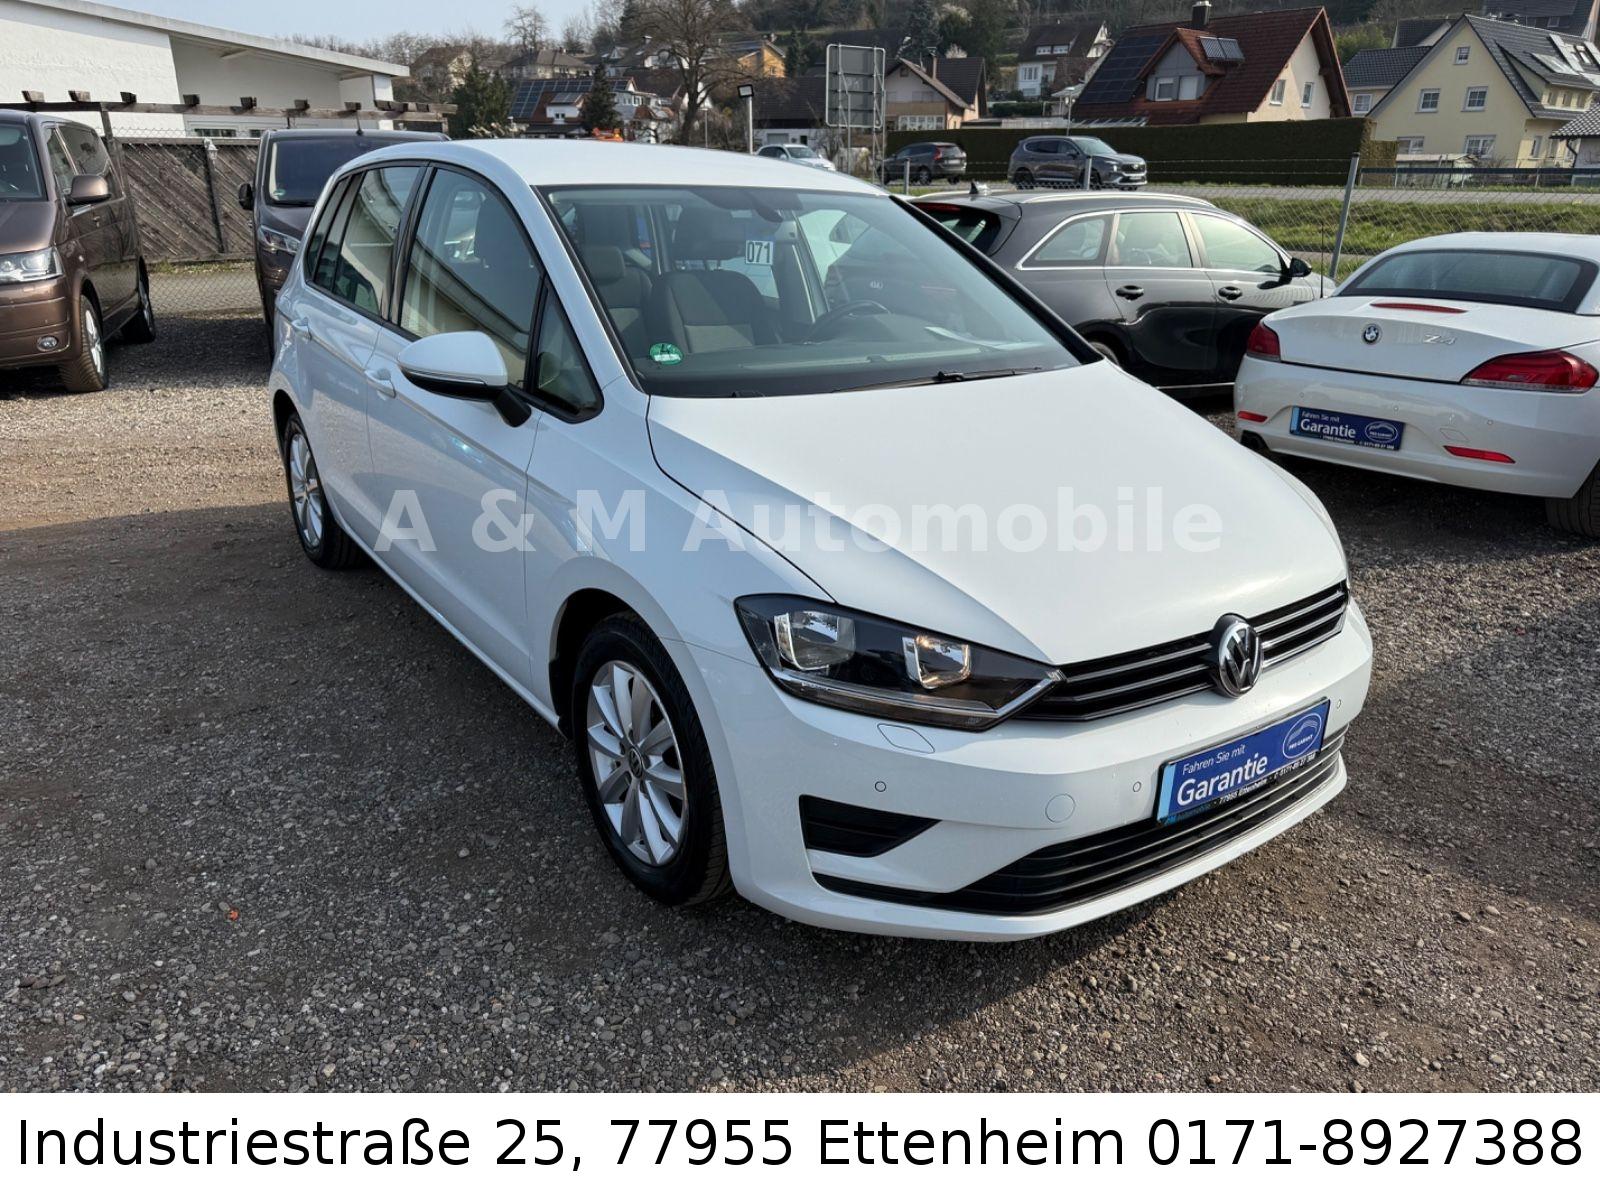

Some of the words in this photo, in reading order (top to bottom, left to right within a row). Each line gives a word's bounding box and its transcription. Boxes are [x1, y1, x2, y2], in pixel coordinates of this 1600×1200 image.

[747, 241, 771, 264] 071
[1423, 334, 1457, 345] Z4
[1300, 418, 1357, 439] Garantie
[1182, 757, 1215, 776] Fahren
[1216, 751, 1230, 764] Sie
[1231, 744, 1246, 758] mit
[1177, 752, 1268, 806] Garantie
